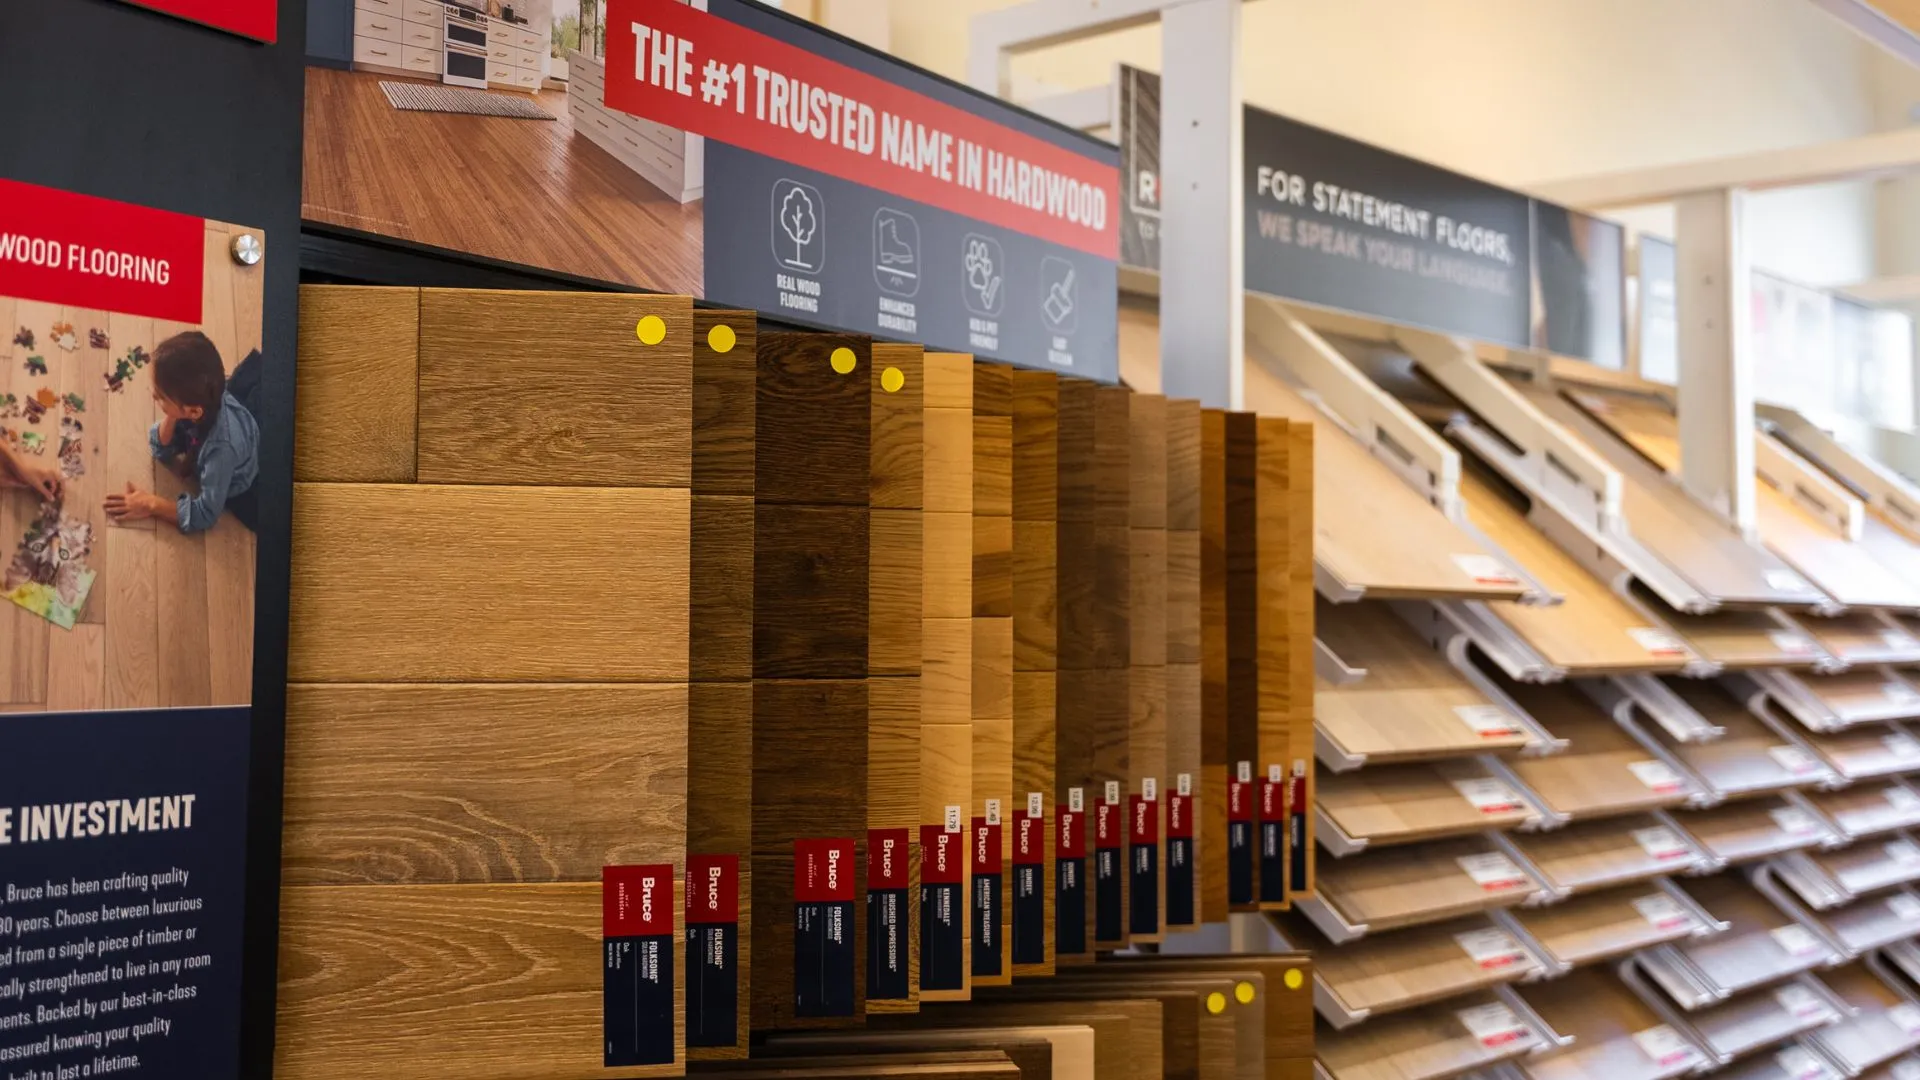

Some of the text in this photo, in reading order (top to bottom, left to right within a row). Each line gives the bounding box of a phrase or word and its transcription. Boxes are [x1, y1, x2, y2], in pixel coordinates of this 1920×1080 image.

[631, 21, 1107, 231] THE #1 TRUSTED NAME IN HARDWOOD
[1139, 169, 1160, 204] R
[1257, 165, 1306, 206] FOR
[1313, 181, 1431, 240] STATEMENT
[0, 232, 170, 285] WOOD FLOORING
[1257, 209, 1293, 244] WE
[1297, 219, 1361, 260] SPEAK
[1364, 235, 1414, 272] YOUR
[776, 274, 820, 297] REAL WOOD
[780, 292, 818, 314] FLOORING
[1172, 797, 1181, 828] Bruce
[1232, 783, 1241, 812] Bruce
[20, 794, 195, 842] INVESTMENT
[1020, 819, 1031, 854] Bruce
[1062, 814, 1072, 848] Bruce
[1099, 806, 1109, 838] Bruce
[1137, 803, 1147, 835] Bruce
[883, 839, 894, 878] Bruce
[938, 835, 948, 871] Bruce
[978, 827, 989, 863] Bruce
[7, 866, 189, 902] Bruce has been crafting quality
[828, 849, 840, 889] Bruce
[642, 877, 655, 922] Bruce
[709, 866, 721, 911] Bruce
[16, 917, 52, 938] years.
[56, 909, 99, 928] Choose
[102, 904, 149, 921] between
[153, 897, 202, 914] luxurious
[888, 894, 896, 923] BRUSHED
[16, 945, 45, 963] from
[48, 947, 56, 959] a
[59, 937, 95, 960] single
[98, 935, 129, 957] piece
[132, 929, 144, 947] of
[147, 925, 182, 945] timber
[186, 926, 197, 940] or
[29, 964, 108, 994] strengthened
[112, 966, 123, 981] to
[126, 962, 146, 978] live
[149, 960, 159, 975] in
[162, 958, 181, 976] any
[184, 953, 211, 970] room
[0, 984, 197, 1029] ents. Backed by our best-in-class
[1, 1016, 171, 1061] assured knowing your quality
[42, 1067, 53, 1080] to
[57, 1063, 79, 1080] last
[83, 1064, 90, 1076] a
[93, 1054, 140, 1075] lifetime.
